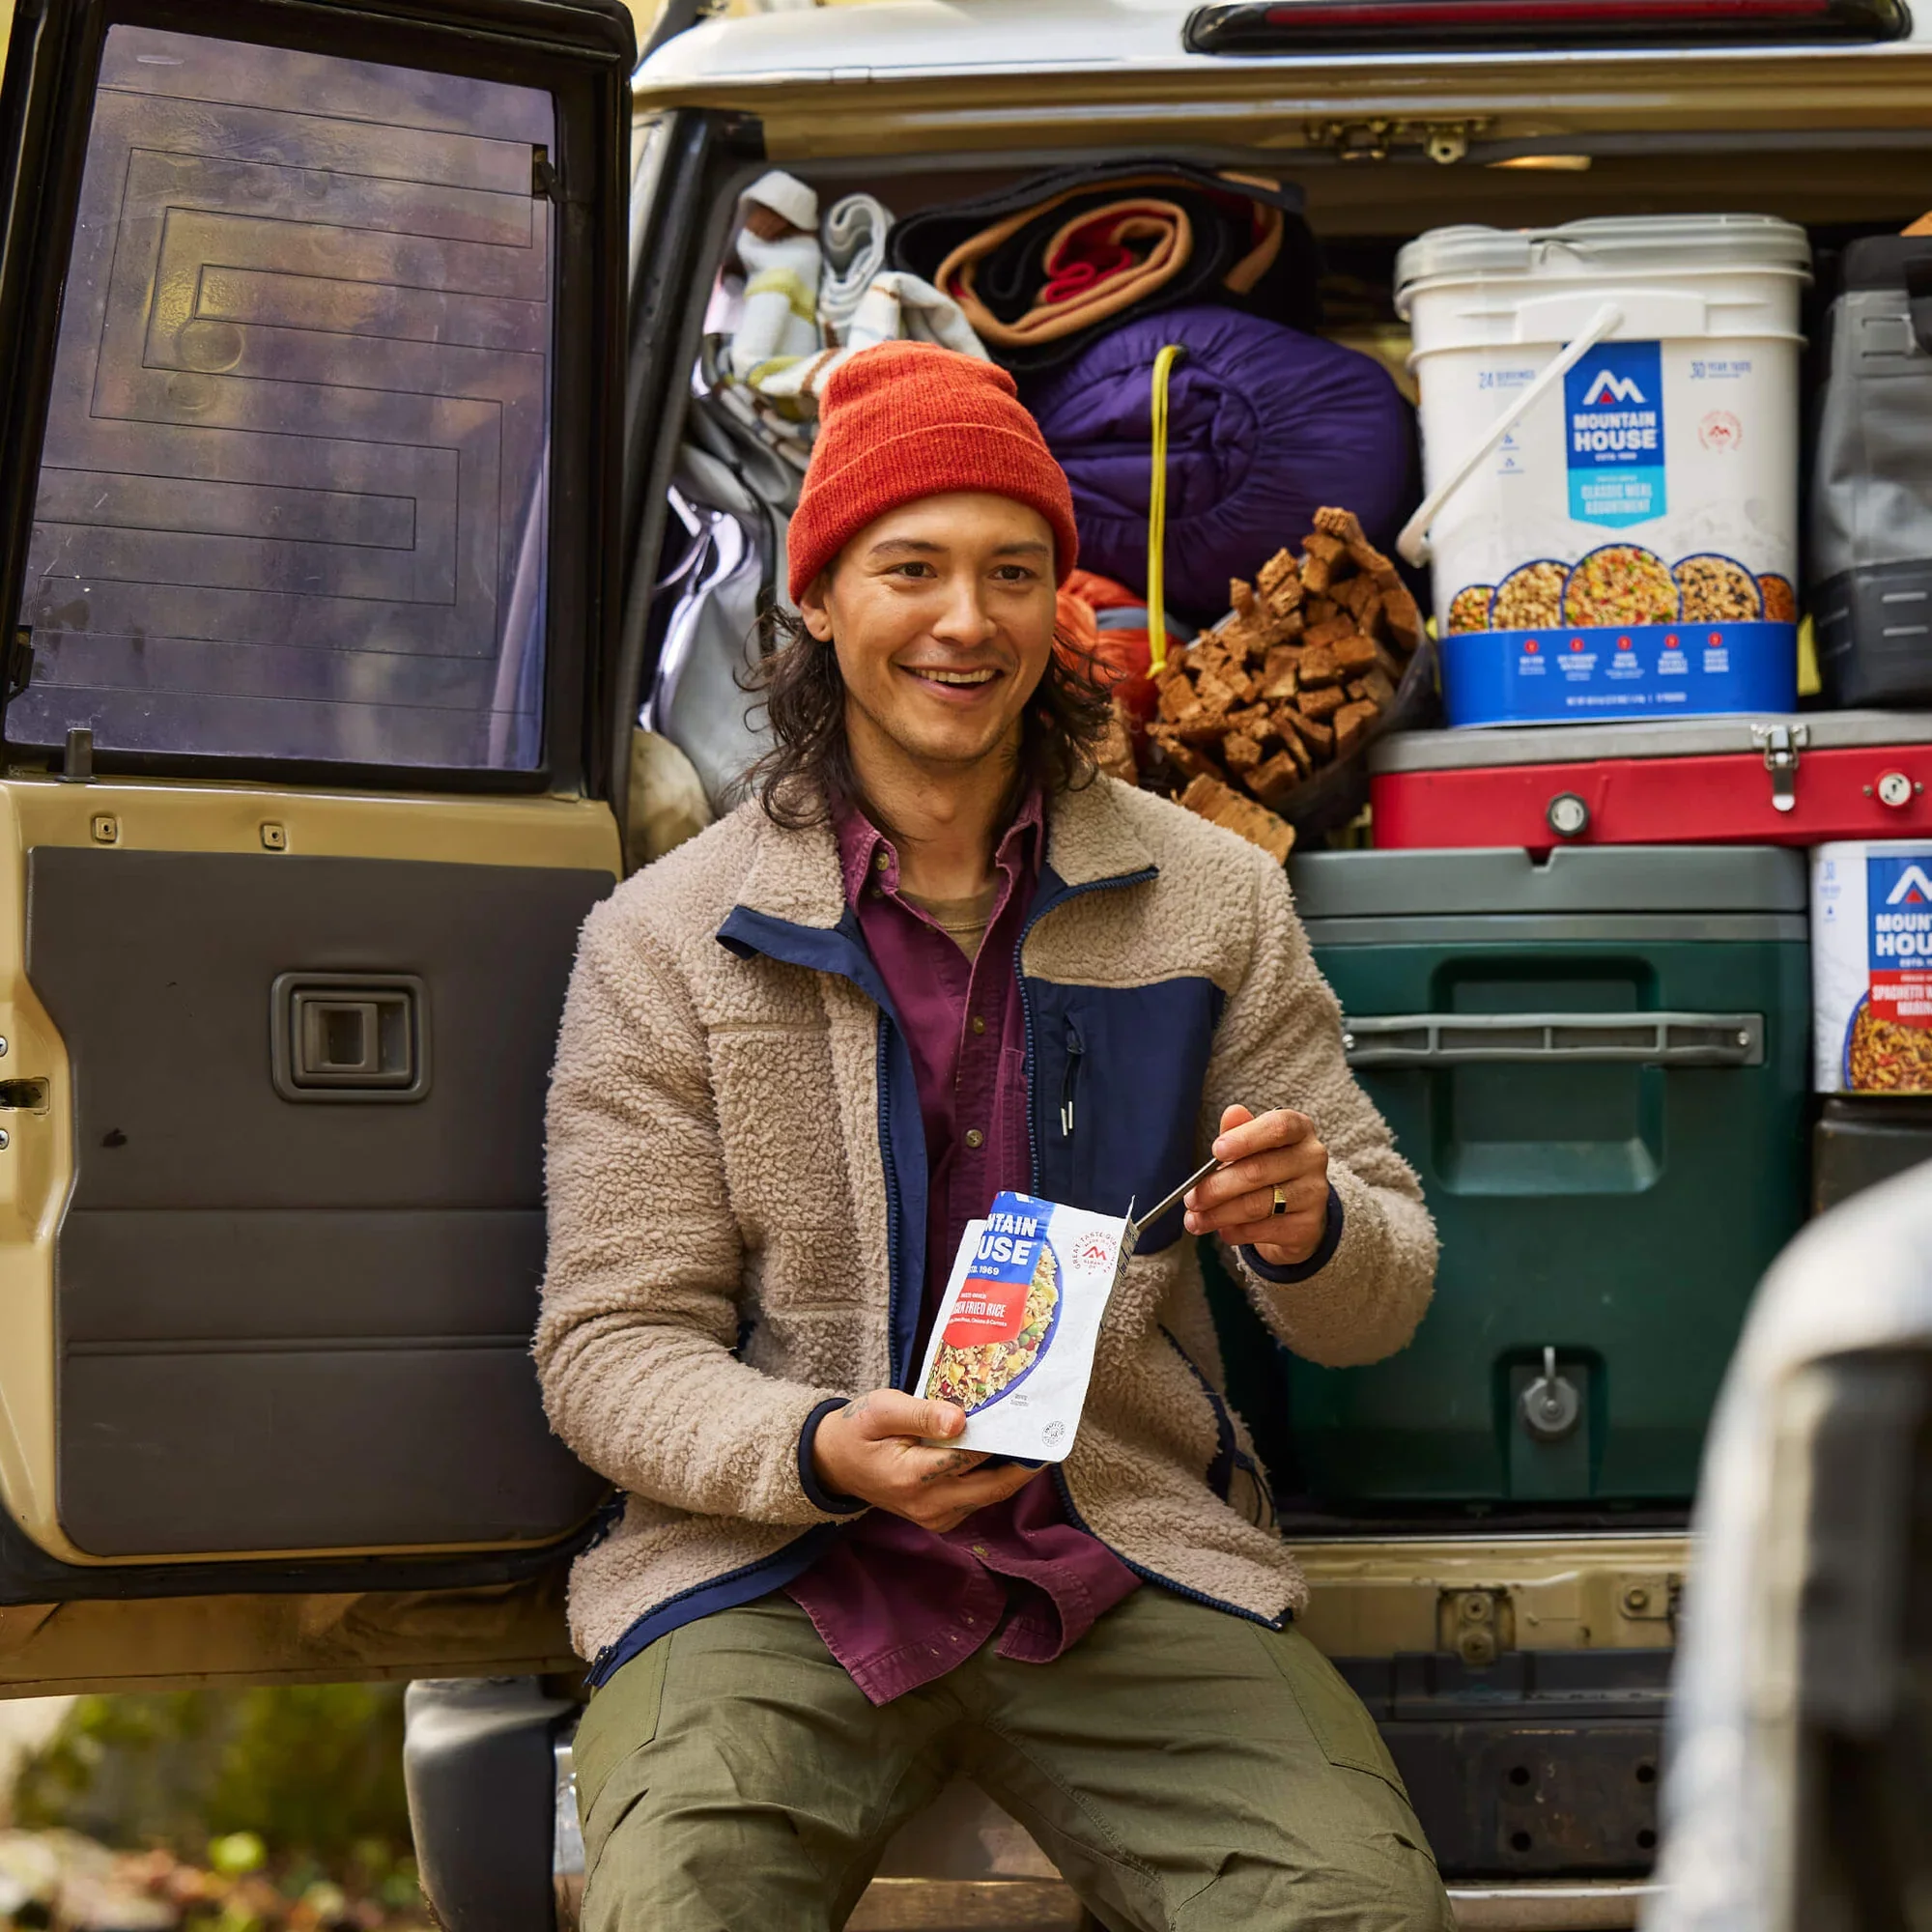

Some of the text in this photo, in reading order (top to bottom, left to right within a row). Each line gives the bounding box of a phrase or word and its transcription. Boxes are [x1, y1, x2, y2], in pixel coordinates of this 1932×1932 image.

[1573, 411, 1657, 431] MOUNTAIN
[1573, 428, 1658, 452] HOUSE
[1875, 913, 1932, 932] MOUN
[1871, 983, 1924, 1001] SPAGHETTI
[979, 1264, 1000, 1276] 1969
[965, 1300, 986, 1316] FRIED
[986, 1302, 1008, 1319] RICE
